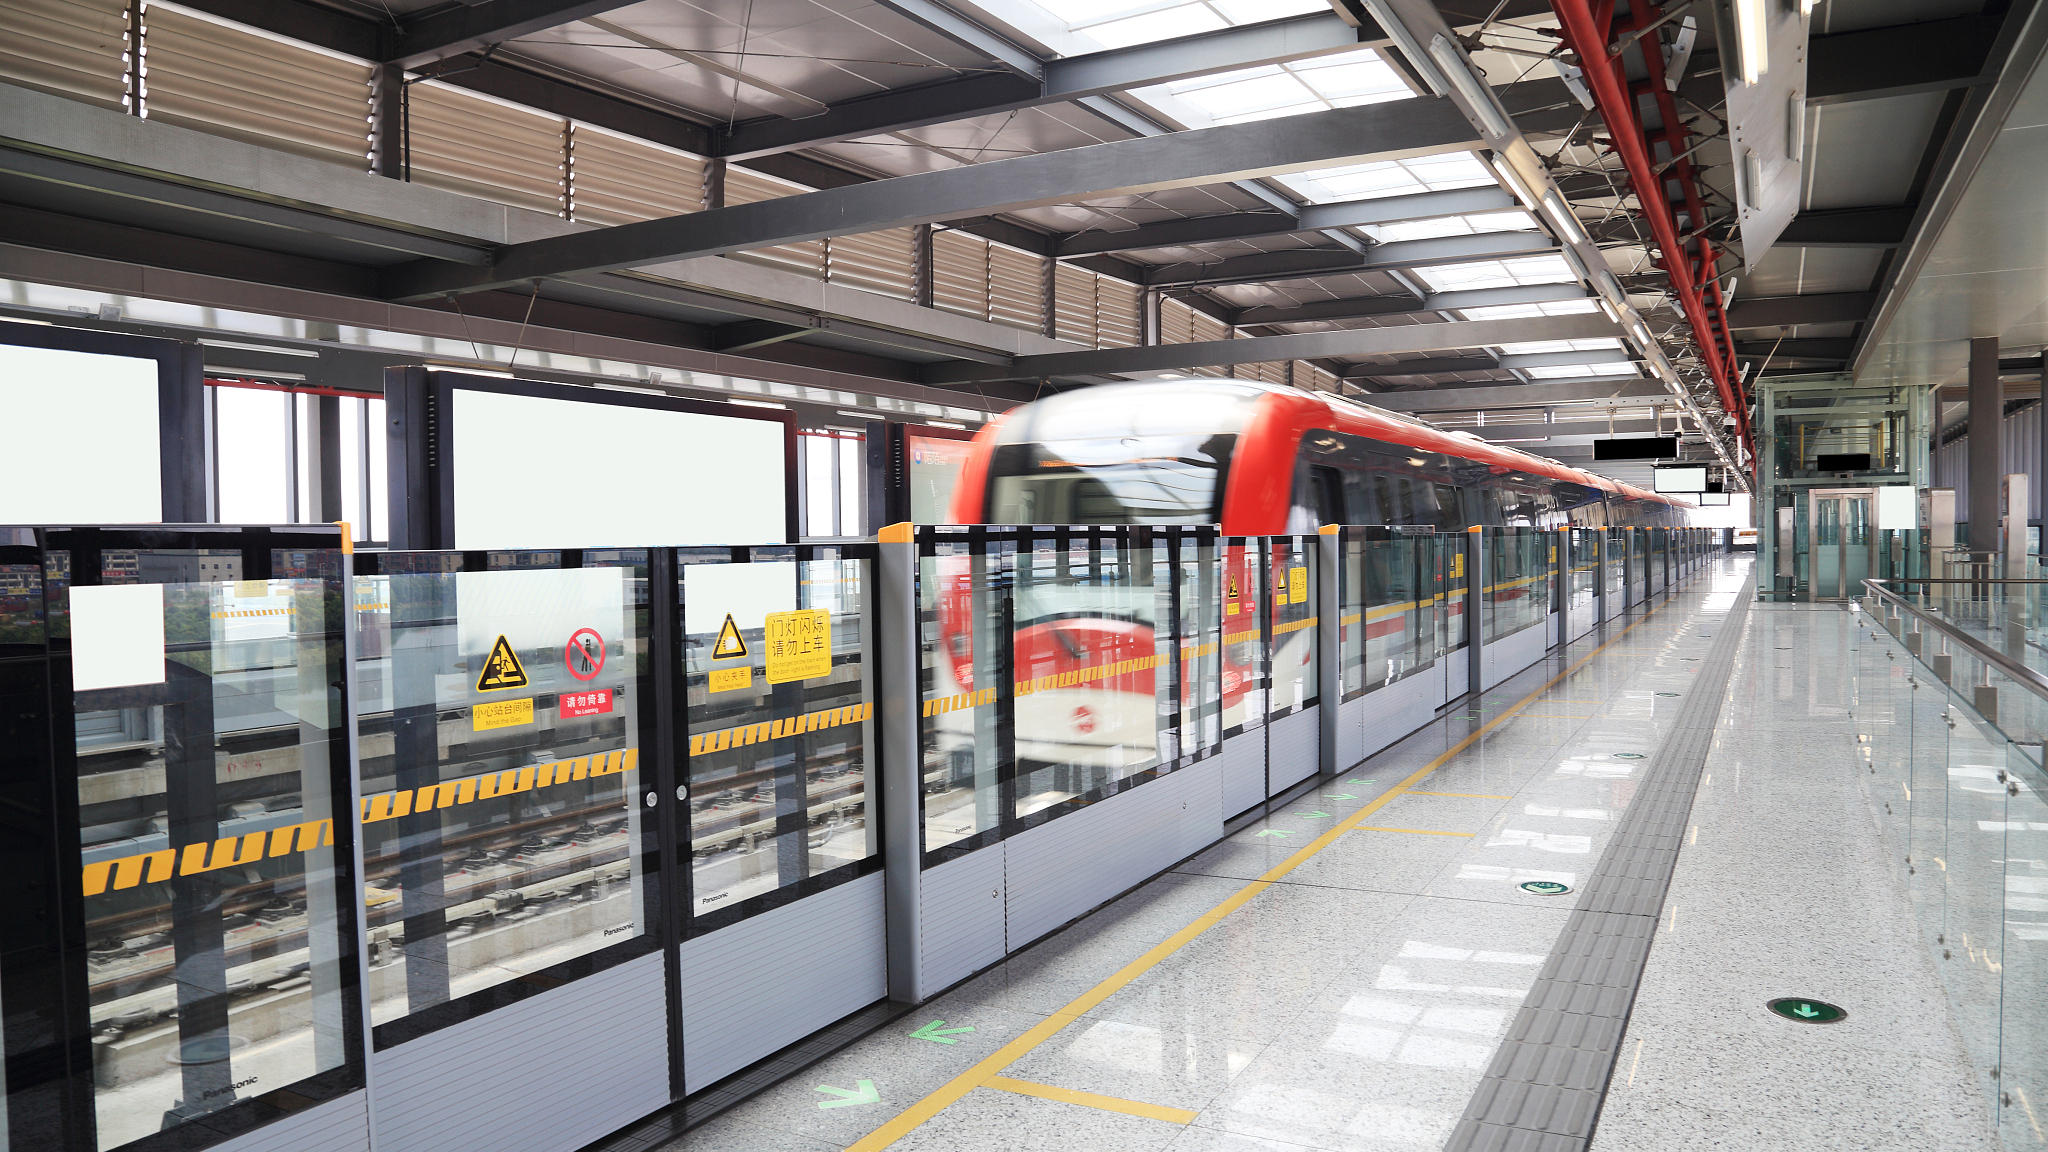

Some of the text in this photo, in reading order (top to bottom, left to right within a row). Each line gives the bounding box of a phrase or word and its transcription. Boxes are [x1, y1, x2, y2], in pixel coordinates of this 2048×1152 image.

[772, 615, 824, 637] 门灯闪烁
[772, 635, 824, 658] 请勿上车
[566, 692, 607, 708] 请勿倚靠
[474, 701, 532, 719] 小心站台间隙
[582, 707, 599, 715] Leaning
[702, 891, 729, 905] Panasonic
[603, 922, 635, 938] Panasonic
[203, 1075, 258, 1101] Panasonic
